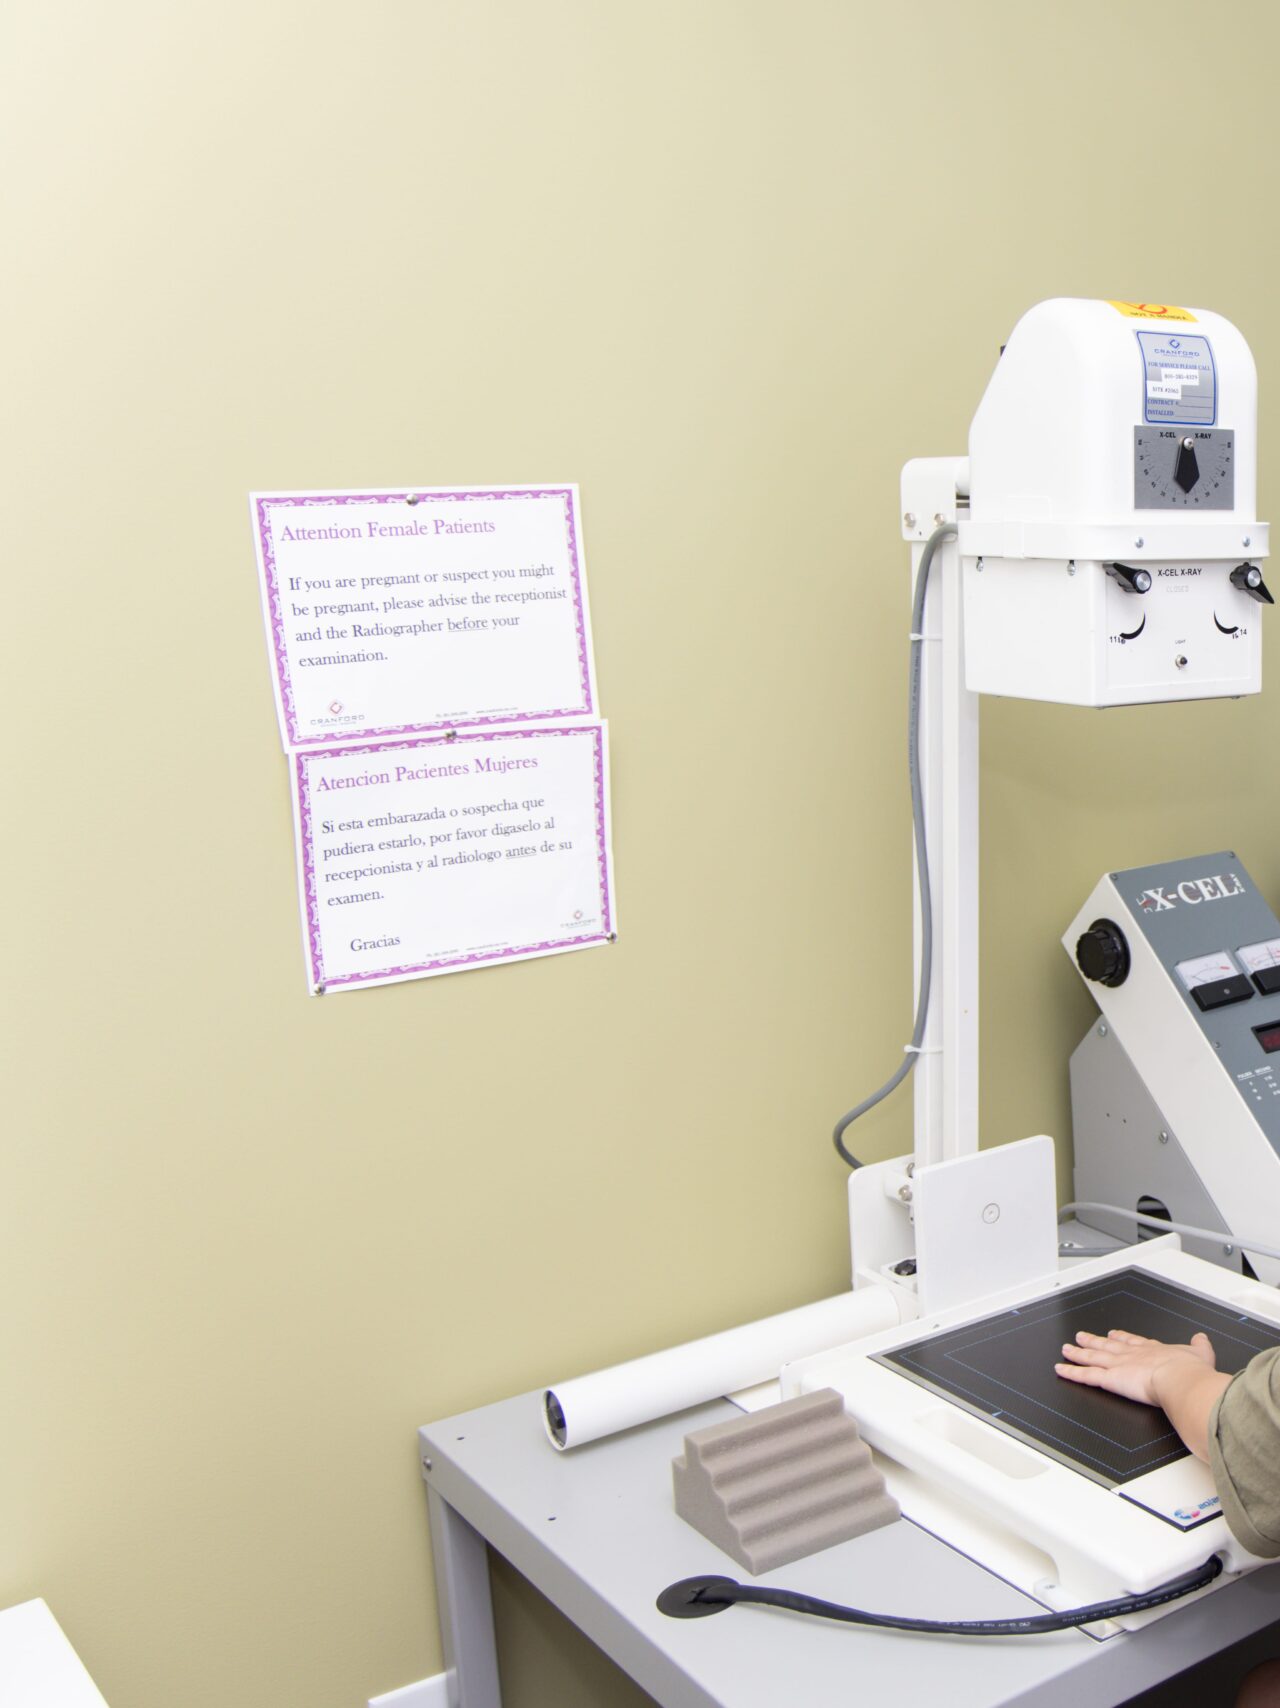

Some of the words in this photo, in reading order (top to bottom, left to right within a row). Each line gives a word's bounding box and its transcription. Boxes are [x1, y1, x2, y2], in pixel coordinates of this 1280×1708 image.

[1154, 348, 1200, 356] CRANFORD
[280, 522, 362, 542] Attention
[367, 520, 428, 538] Female
[434, 518, 496, 535] Patients
[288, 577, 301, 591] If
[304, 578, 331, 593] you
[335, 576, 357, 588] are
[361, 572, 420, 589] pregnant
[424, 573, 439, 583] or
[442, 569, 489, 583] suspect
[492, 568, 516, 582] you
[519, 564, 554, 580] might
[1157, 568, 1179, 577] X-CEL
[1180, 568, 1202, 576] X-RAY
[292, 603, 309, 617] be
[314, 599, 379, 618] pregnant,
[383, 596, 424, 613] please
[428, 592, 467, 608] advise
[471, 591, 491, 604] the
[495, 586, 568, 604] receptionist
[296, 628, 322, 642] and
[326, 625, 348, 640] the
[352, 619, 444, 639] Radiographer
[448, 616, 489, 632] before
[491, 614, 520, 631] your
[299, 649, 388, 668] examination.
[310, 714, 365, 726] CRANFORD
[317, 770, 390, 792] Atencion
[395, 762, 470, 783] Pacientes
[475, 756, 538, 776] Mujeres
[321, 819, 335, 834] Si
[338, 818, 364, 832] esta
[367, 807, 446, 828] embarazada
[450, 808, 459, 817] o
[462, 798, 519, 819] sospecha
[522, 797, 545, 812] que
[323, 841, 374, 861] pudiera
[378, 833, 426, 850] estarlo,
[430, 831, 452, 848] por
[456, 825, 488, 841] favor
[491, 819, 541, 839] digaselo
[544, 817, 555, 830] al
[325, 859, 413, 883] recepcionista
[416, 859, 424, 871] y
[427, 855, 439, 868] al
[442, 848, 502, 868] radiologo
[505, 844, 537, 859] antes
[540, 840, 556, 853] de
[558, 840, 573, 851] su
[327, 889, 385, 908] examen.
[1144, 873, 1238, 912] X-CEL
[349, 934, 401, 953] Gracias
